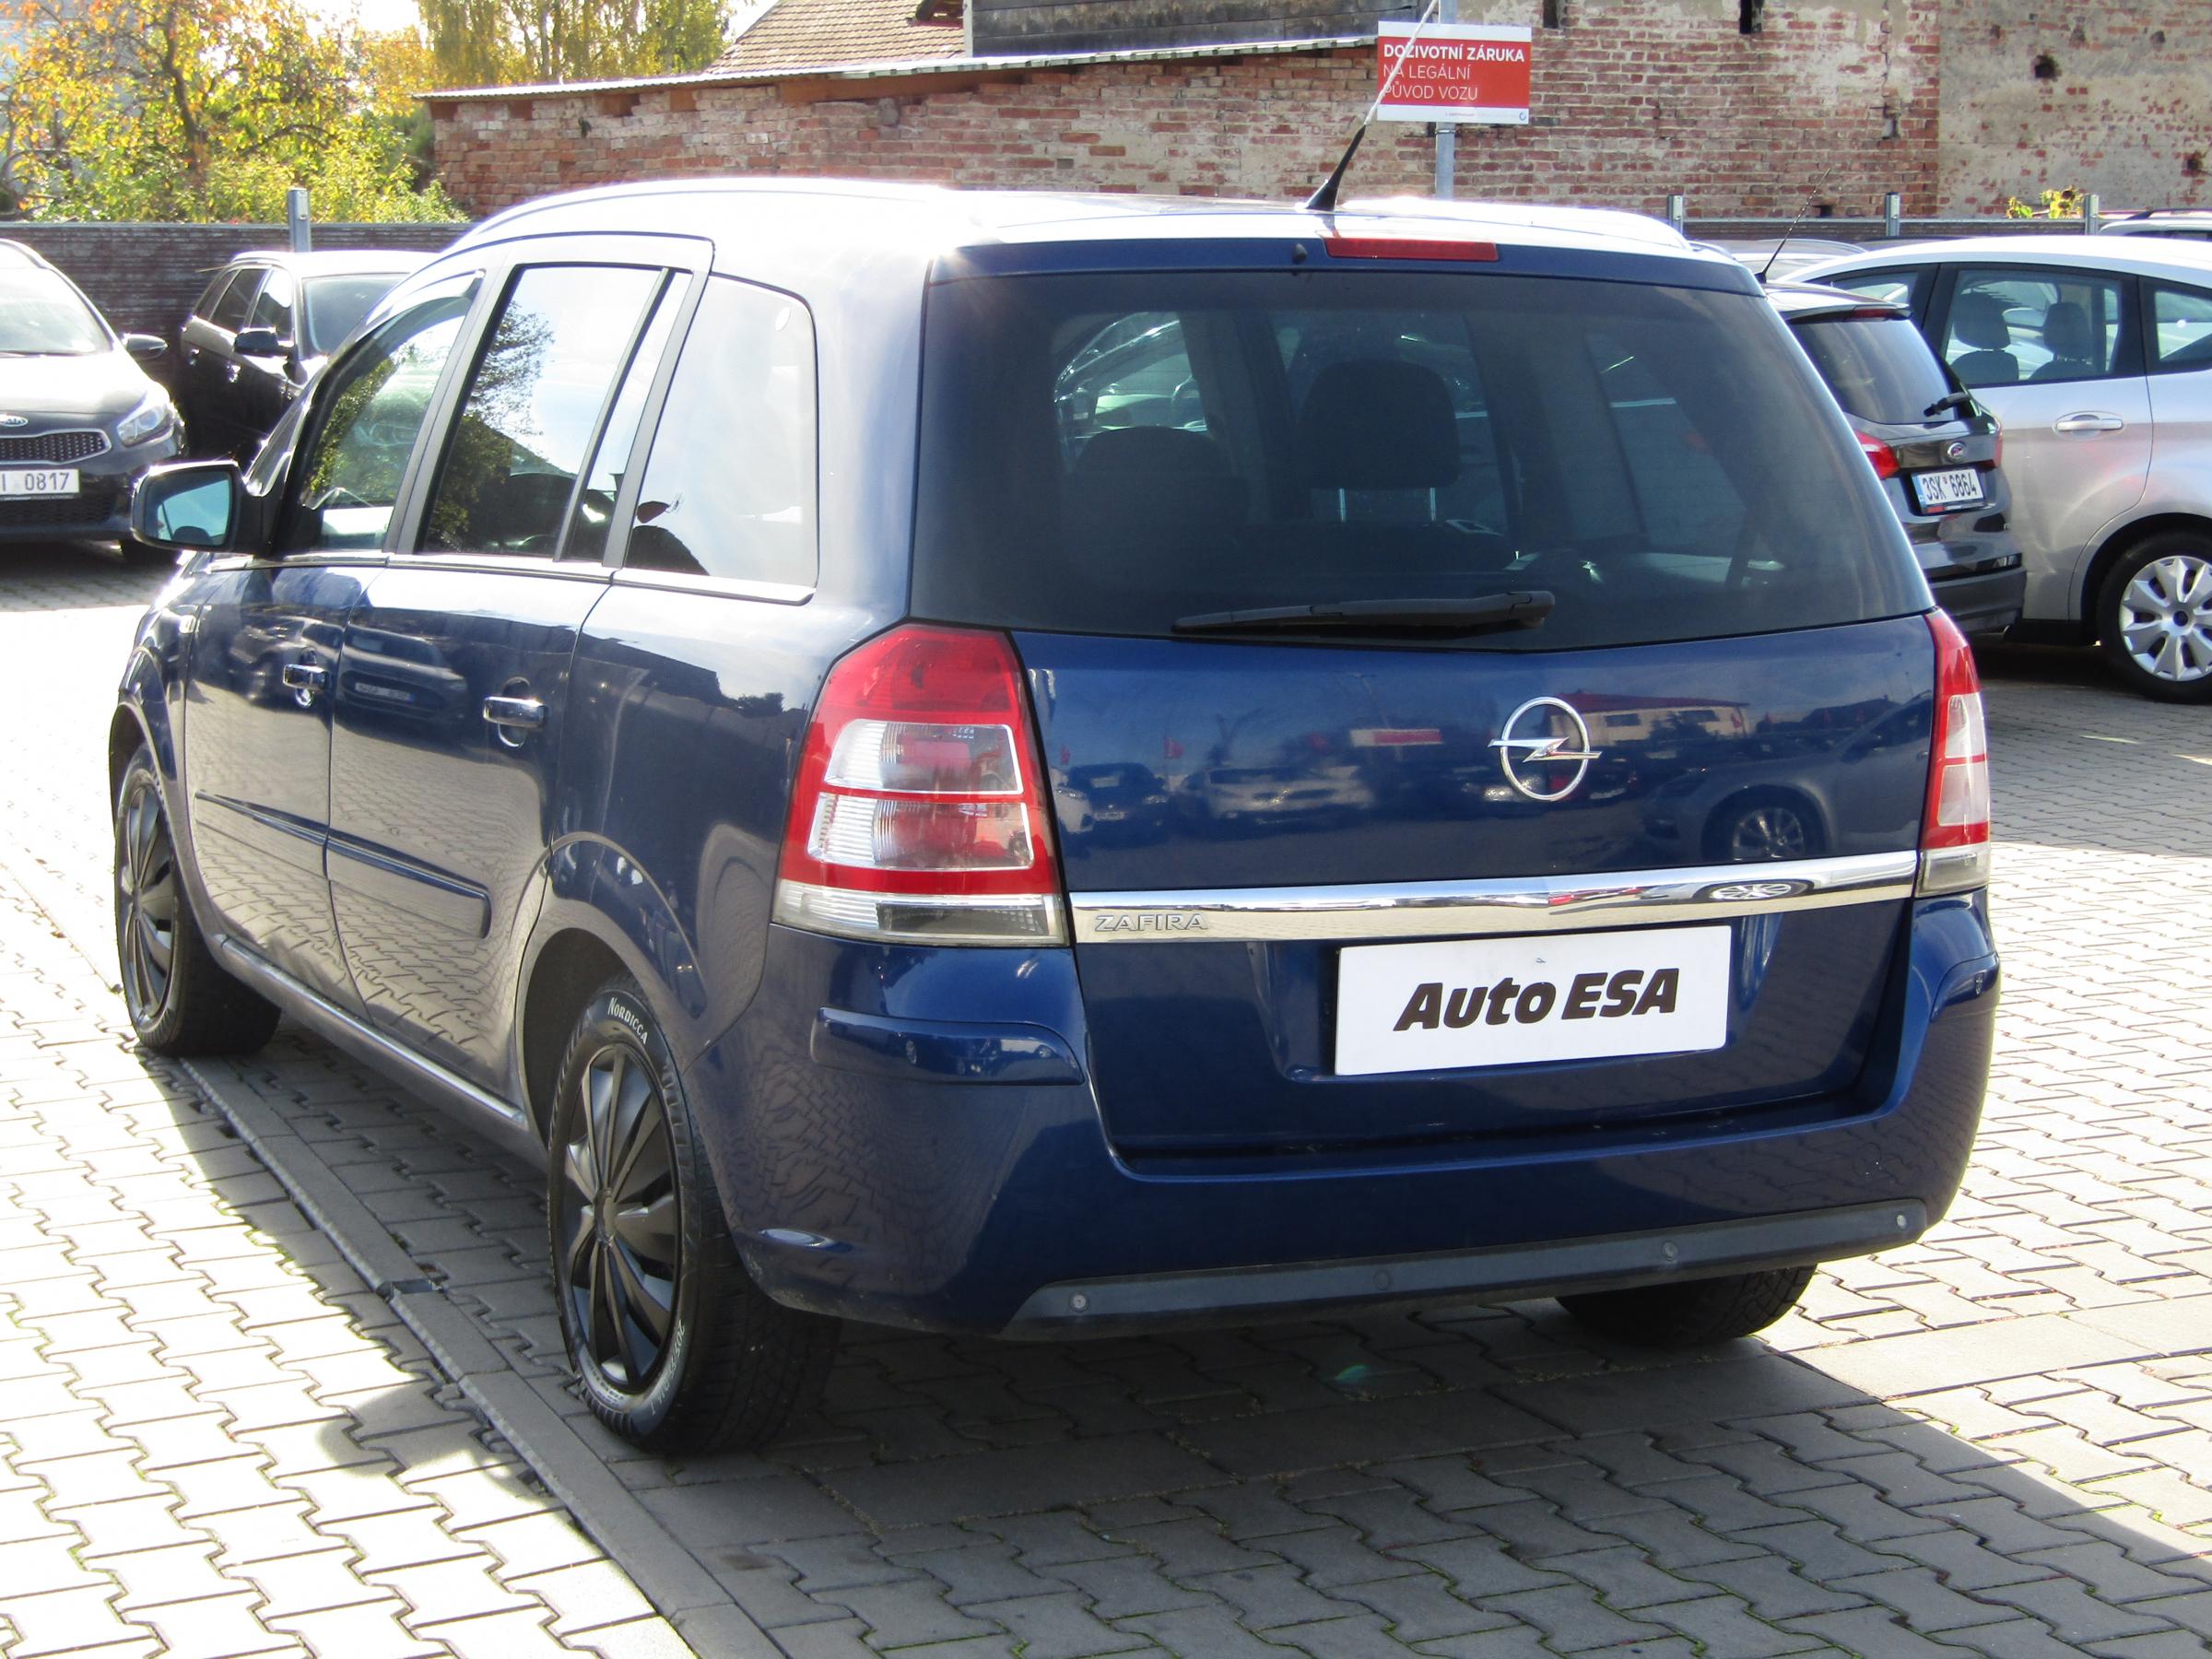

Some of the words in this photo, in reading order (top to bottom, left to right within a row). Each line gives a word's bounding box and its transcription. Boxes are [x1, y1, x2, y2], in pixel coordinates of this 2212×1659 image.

[1466, 44, 1525, 63] ZÁRUKA
[1409, 64, 1471, 80] LEGÁLNÍ
[1438, 86, 1479, 100] VOZU
[25, 472, 70, 491] 0817
[1923, 476, 1947, 500] 3SK
[1949, 473, 1977, 498] 6864
[1095, 913, 1208, 932] ZAFIRA
[1394, 977, 1557, 1031] Auto
[1561, 968, 1679, 1020] ESA
[607, 996, 648, 1045] NORDICCA
